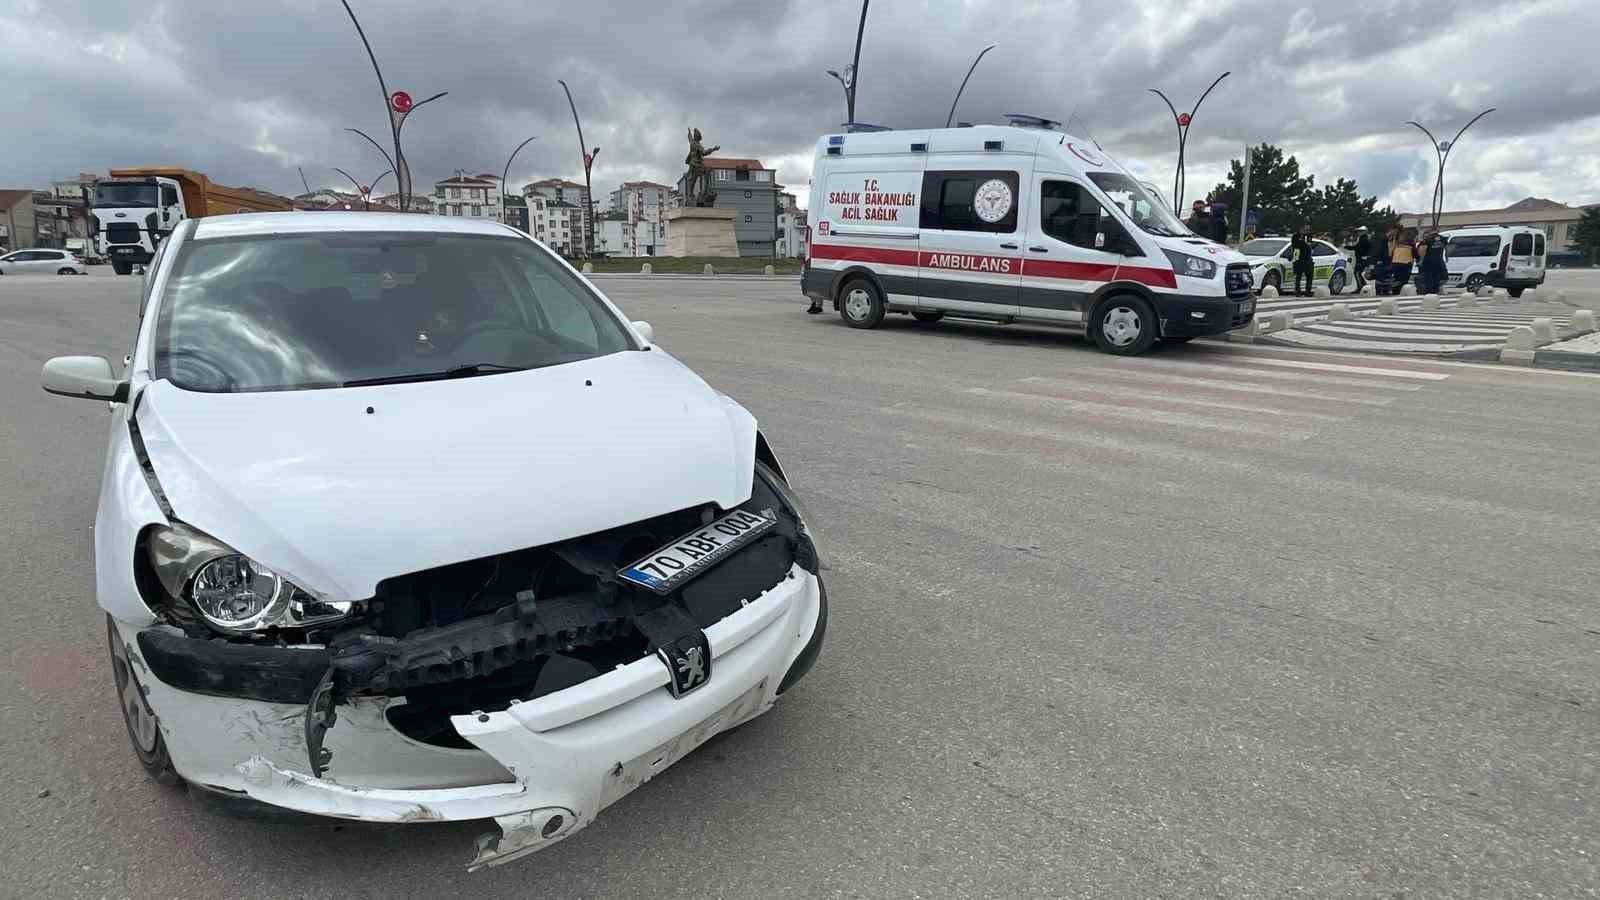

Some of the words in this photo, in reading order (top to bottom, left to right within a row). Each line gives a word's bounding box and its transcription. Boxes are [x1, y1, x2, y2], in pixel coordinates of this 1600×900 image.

[864, 179, 880, 192] T.C.
[829, 190, 861, 205] SAĞLIK
[864, 191, 916, 206] BAKANLIĞI
[864, 207, 898, 221] SAĞLIK
[928, 254, 1011, 272] AMBULANS
[639, 556, 685, 578] 70
[675, 531, 722, 560] ABF
[715, 511, 761, 536] 004
